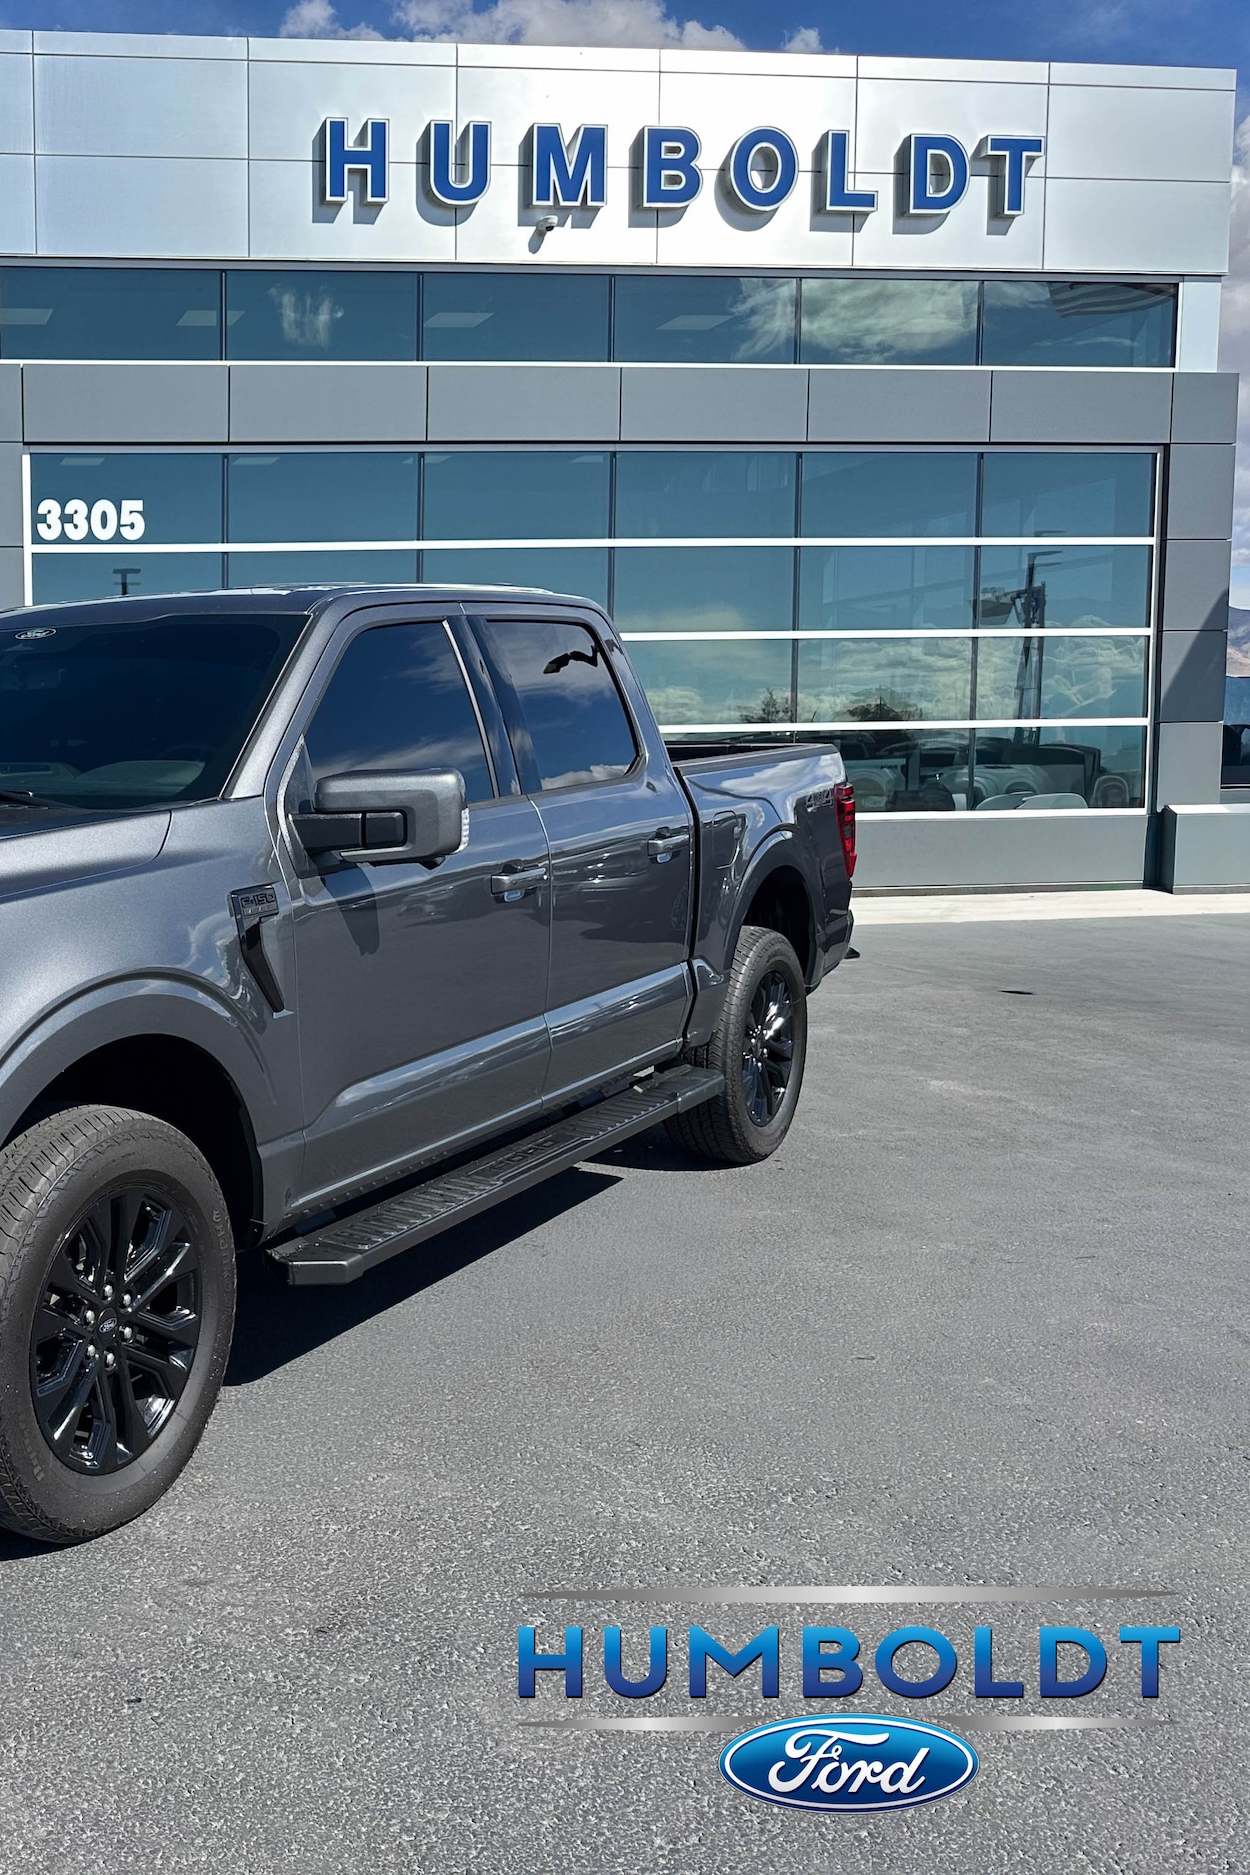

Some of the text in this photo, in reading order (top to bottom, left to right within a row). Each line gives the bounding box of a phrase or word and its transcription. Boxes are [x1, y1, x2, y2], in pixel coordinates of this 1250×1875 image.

[324, 117, 1046, 217] HUMBOLDT
[36, 499, 146, 541] 3305
[240, 893, 277, 909] F-150
